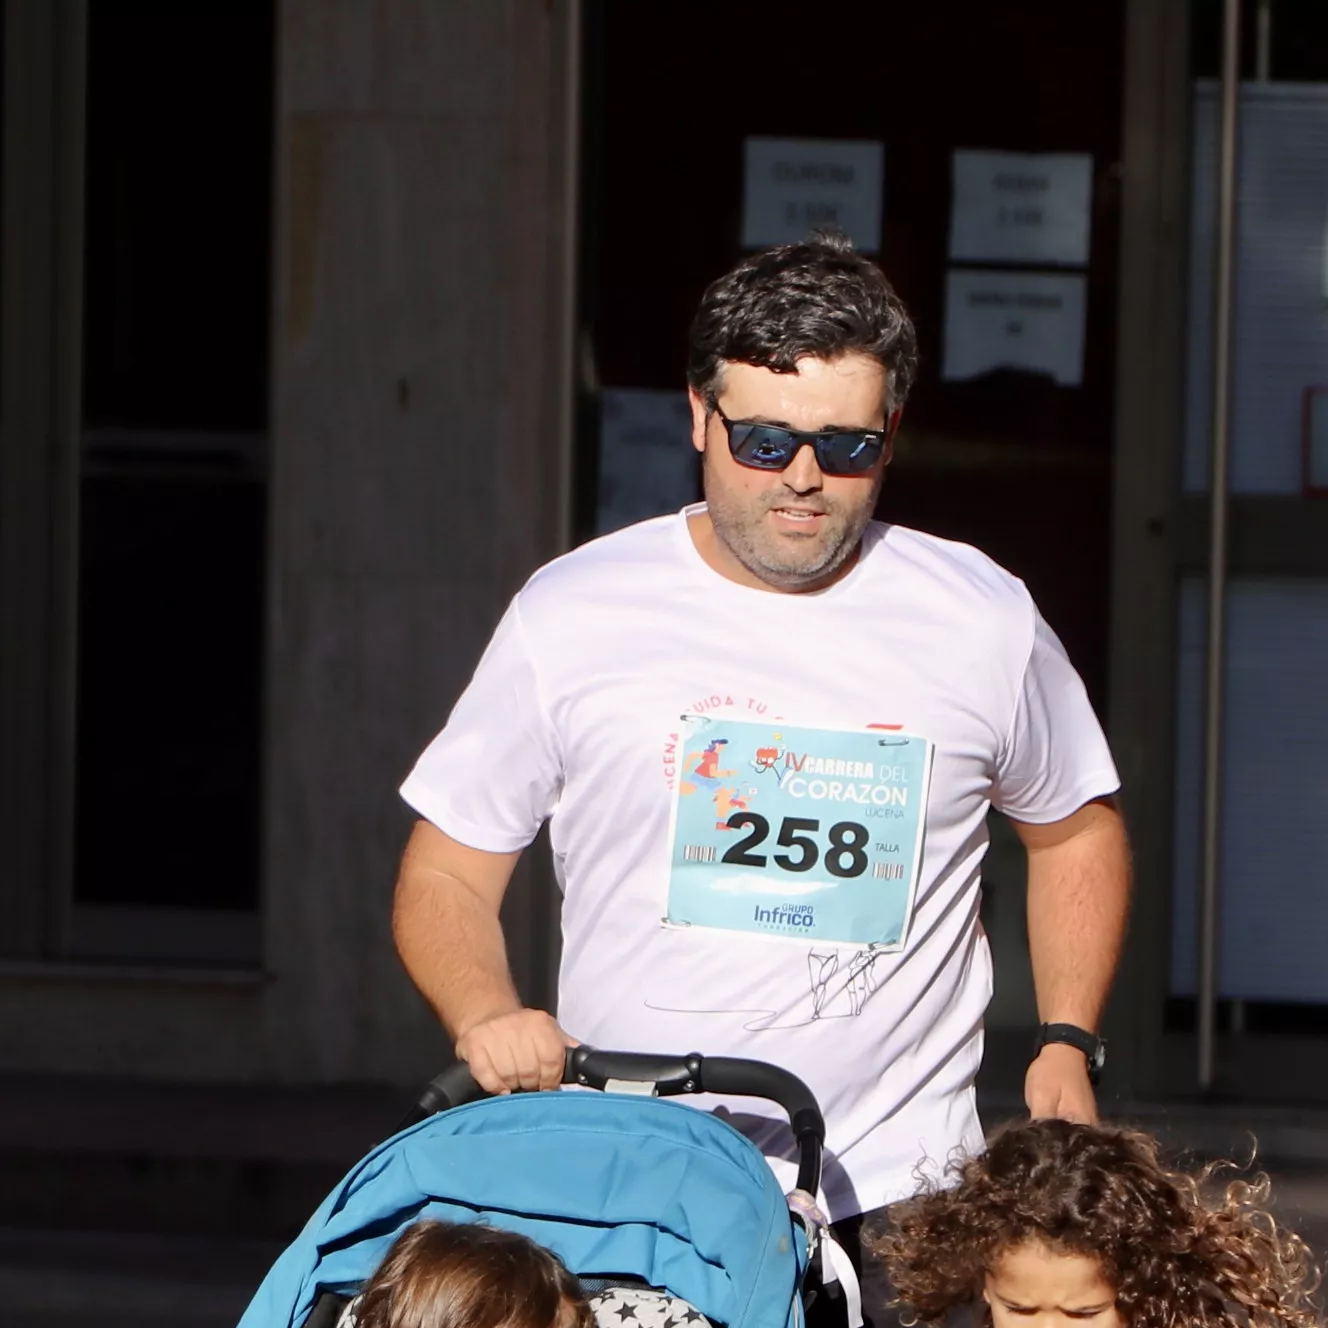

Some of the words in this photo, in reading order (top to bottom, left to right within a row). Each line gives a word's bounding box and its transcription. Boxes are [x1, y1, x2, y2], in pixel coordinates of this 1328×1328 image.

[747, 698, 767, 714] TU
[785, 752, 807, 772] IV
[805, 756, 873, 779] CARRERA
[879, 765, 908, 782] DEL
[788, 777, 908, 807] CORAZÓN
[865, 807, 905, 819] LUCENA
[722, 812, 870, 878] 258
[875, 842, 900, 853] TALLA
[754, 905, 814, 927] Infrico
[782, 903, 814, 914] GRUPO
